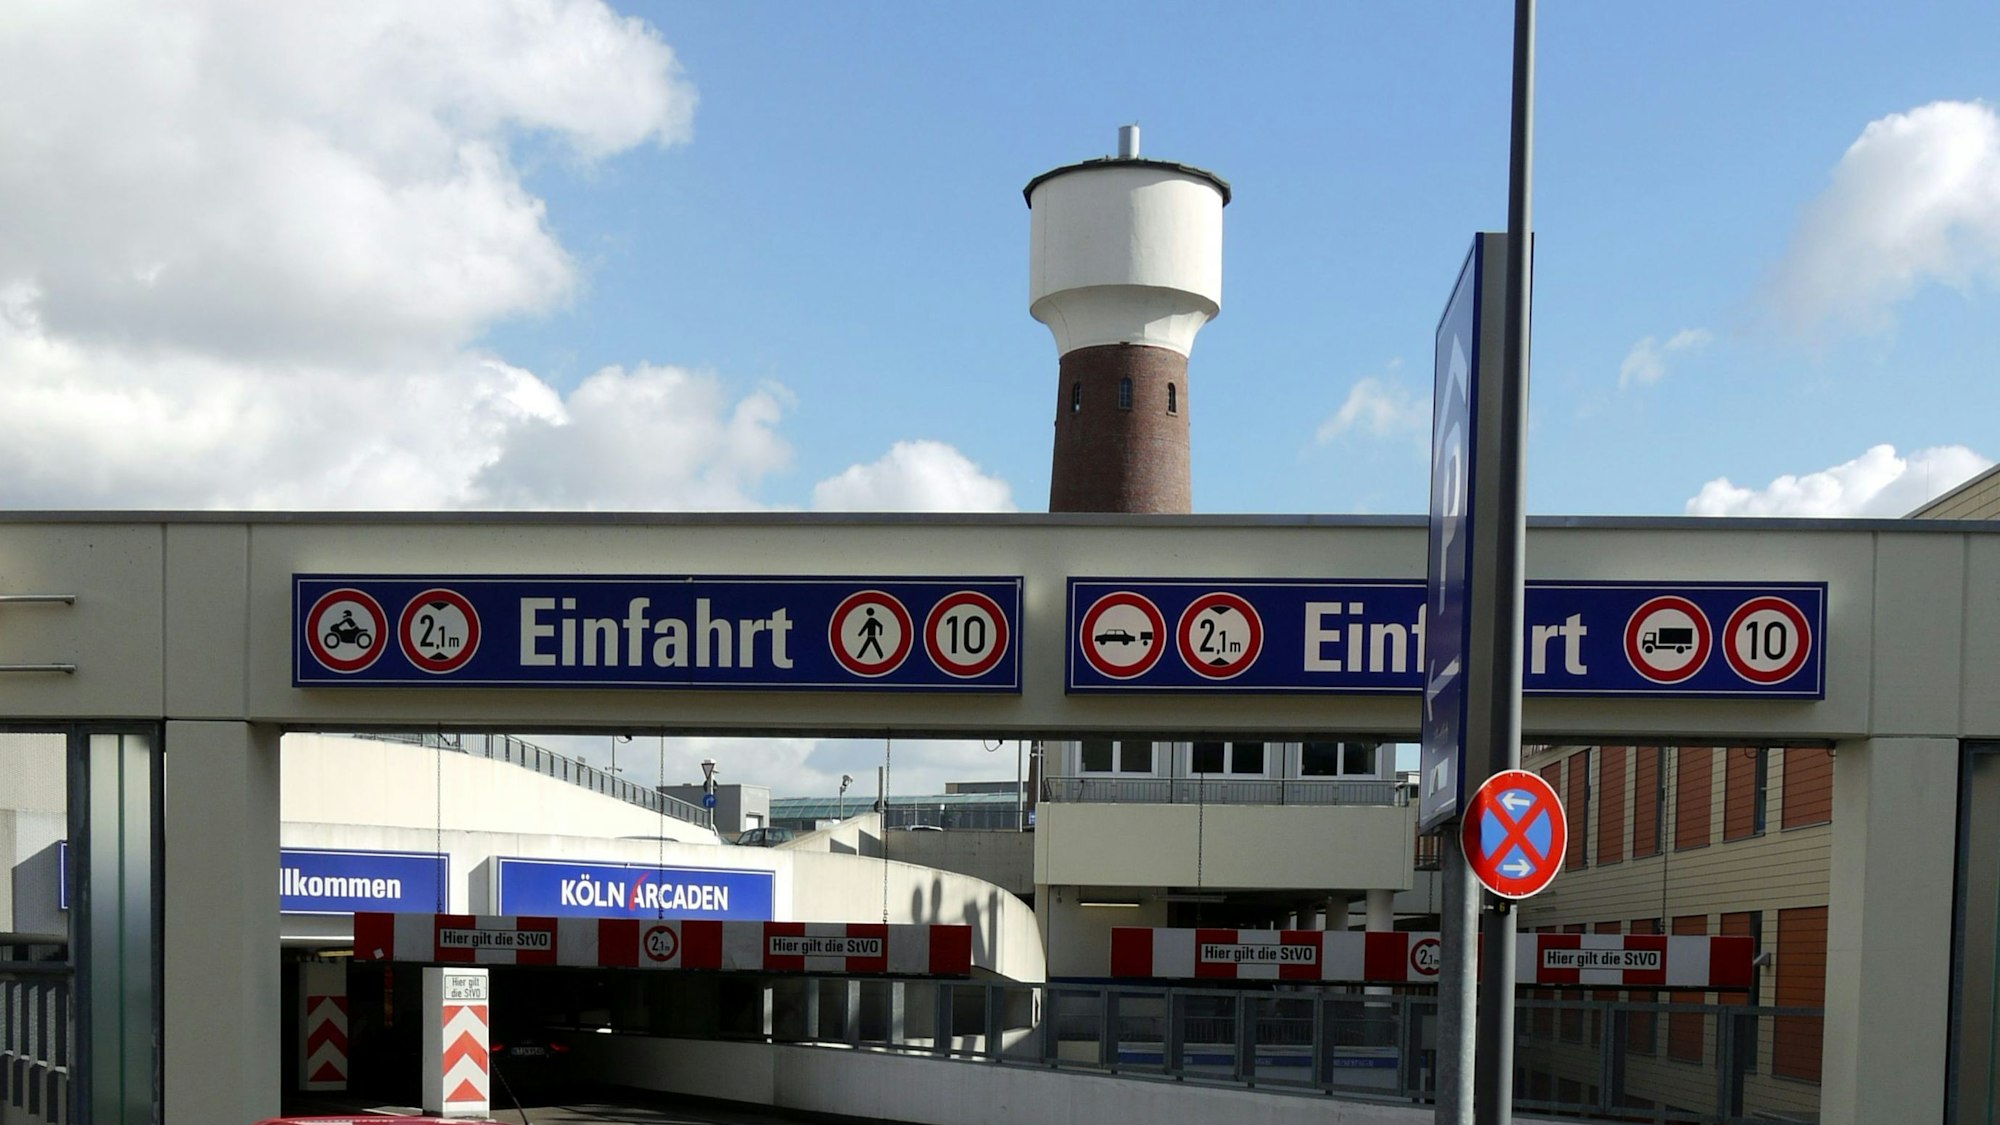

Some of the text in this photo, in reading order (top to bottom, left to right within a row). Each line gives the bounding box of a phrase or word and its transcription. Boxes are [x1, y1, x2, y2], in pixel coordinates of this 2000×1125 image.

[520, 597, 794, 669] Einfahrt
[946, 615, 985, 654] 10
[1303, 601, 1588, 676] Einfrt
[1746, 621, 1787, 660] 10
[561, 872, 729, 911] KÖLN ARCADEN
[443, 931, 548, 947] Hier gilt die StVO
[773, 939, 879, 954] Hier gilt die StVO
[1205, 946, 1313, 962] Hier gilt die StVO
[1547, 951, 1657, 967] Hier gilt die StVO
[452, 976, 480, 988] Hier gilt
[451, 988, 481, 998] die StVO
